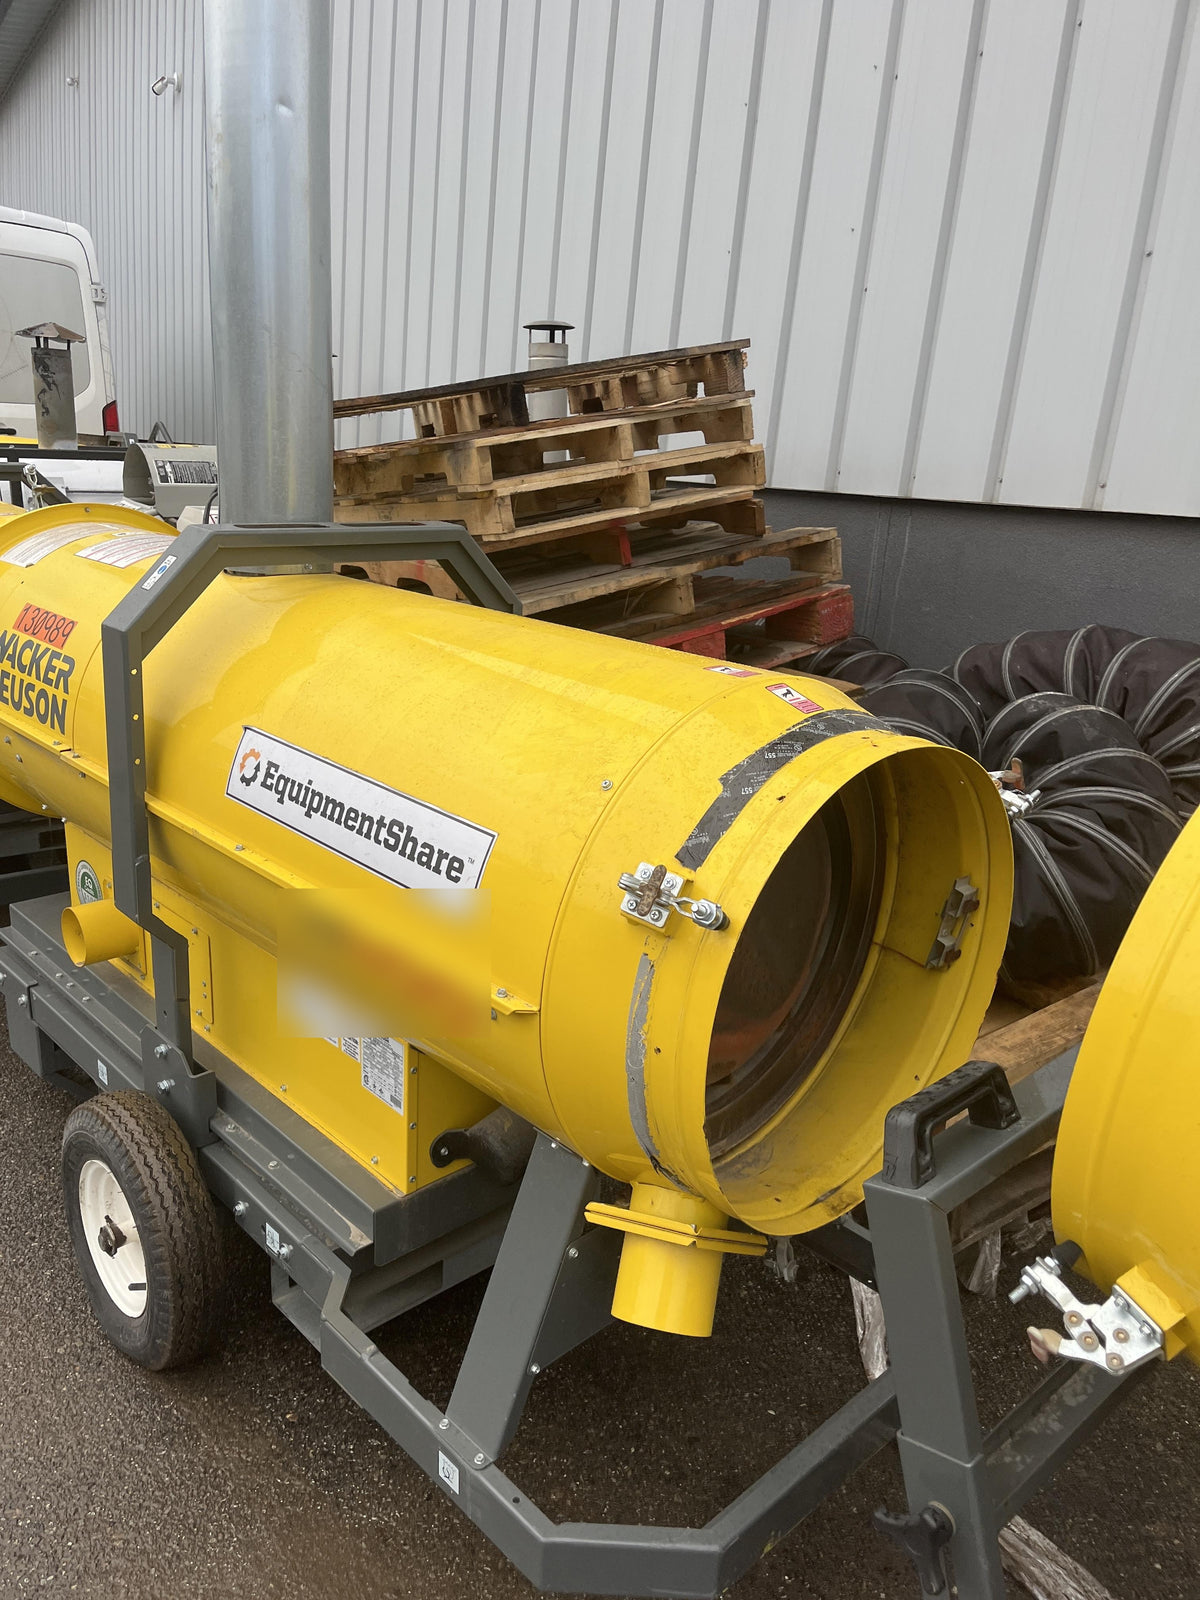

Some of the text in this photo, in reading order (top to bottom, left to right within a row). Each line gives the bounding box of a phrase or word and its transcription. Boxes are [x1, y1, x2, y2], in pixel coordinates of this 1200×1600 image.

[0, 669, 68, 736] EUSON
[260, 760, 465, 883] EquipmentShare
[741, 787, 753, 795] 557
